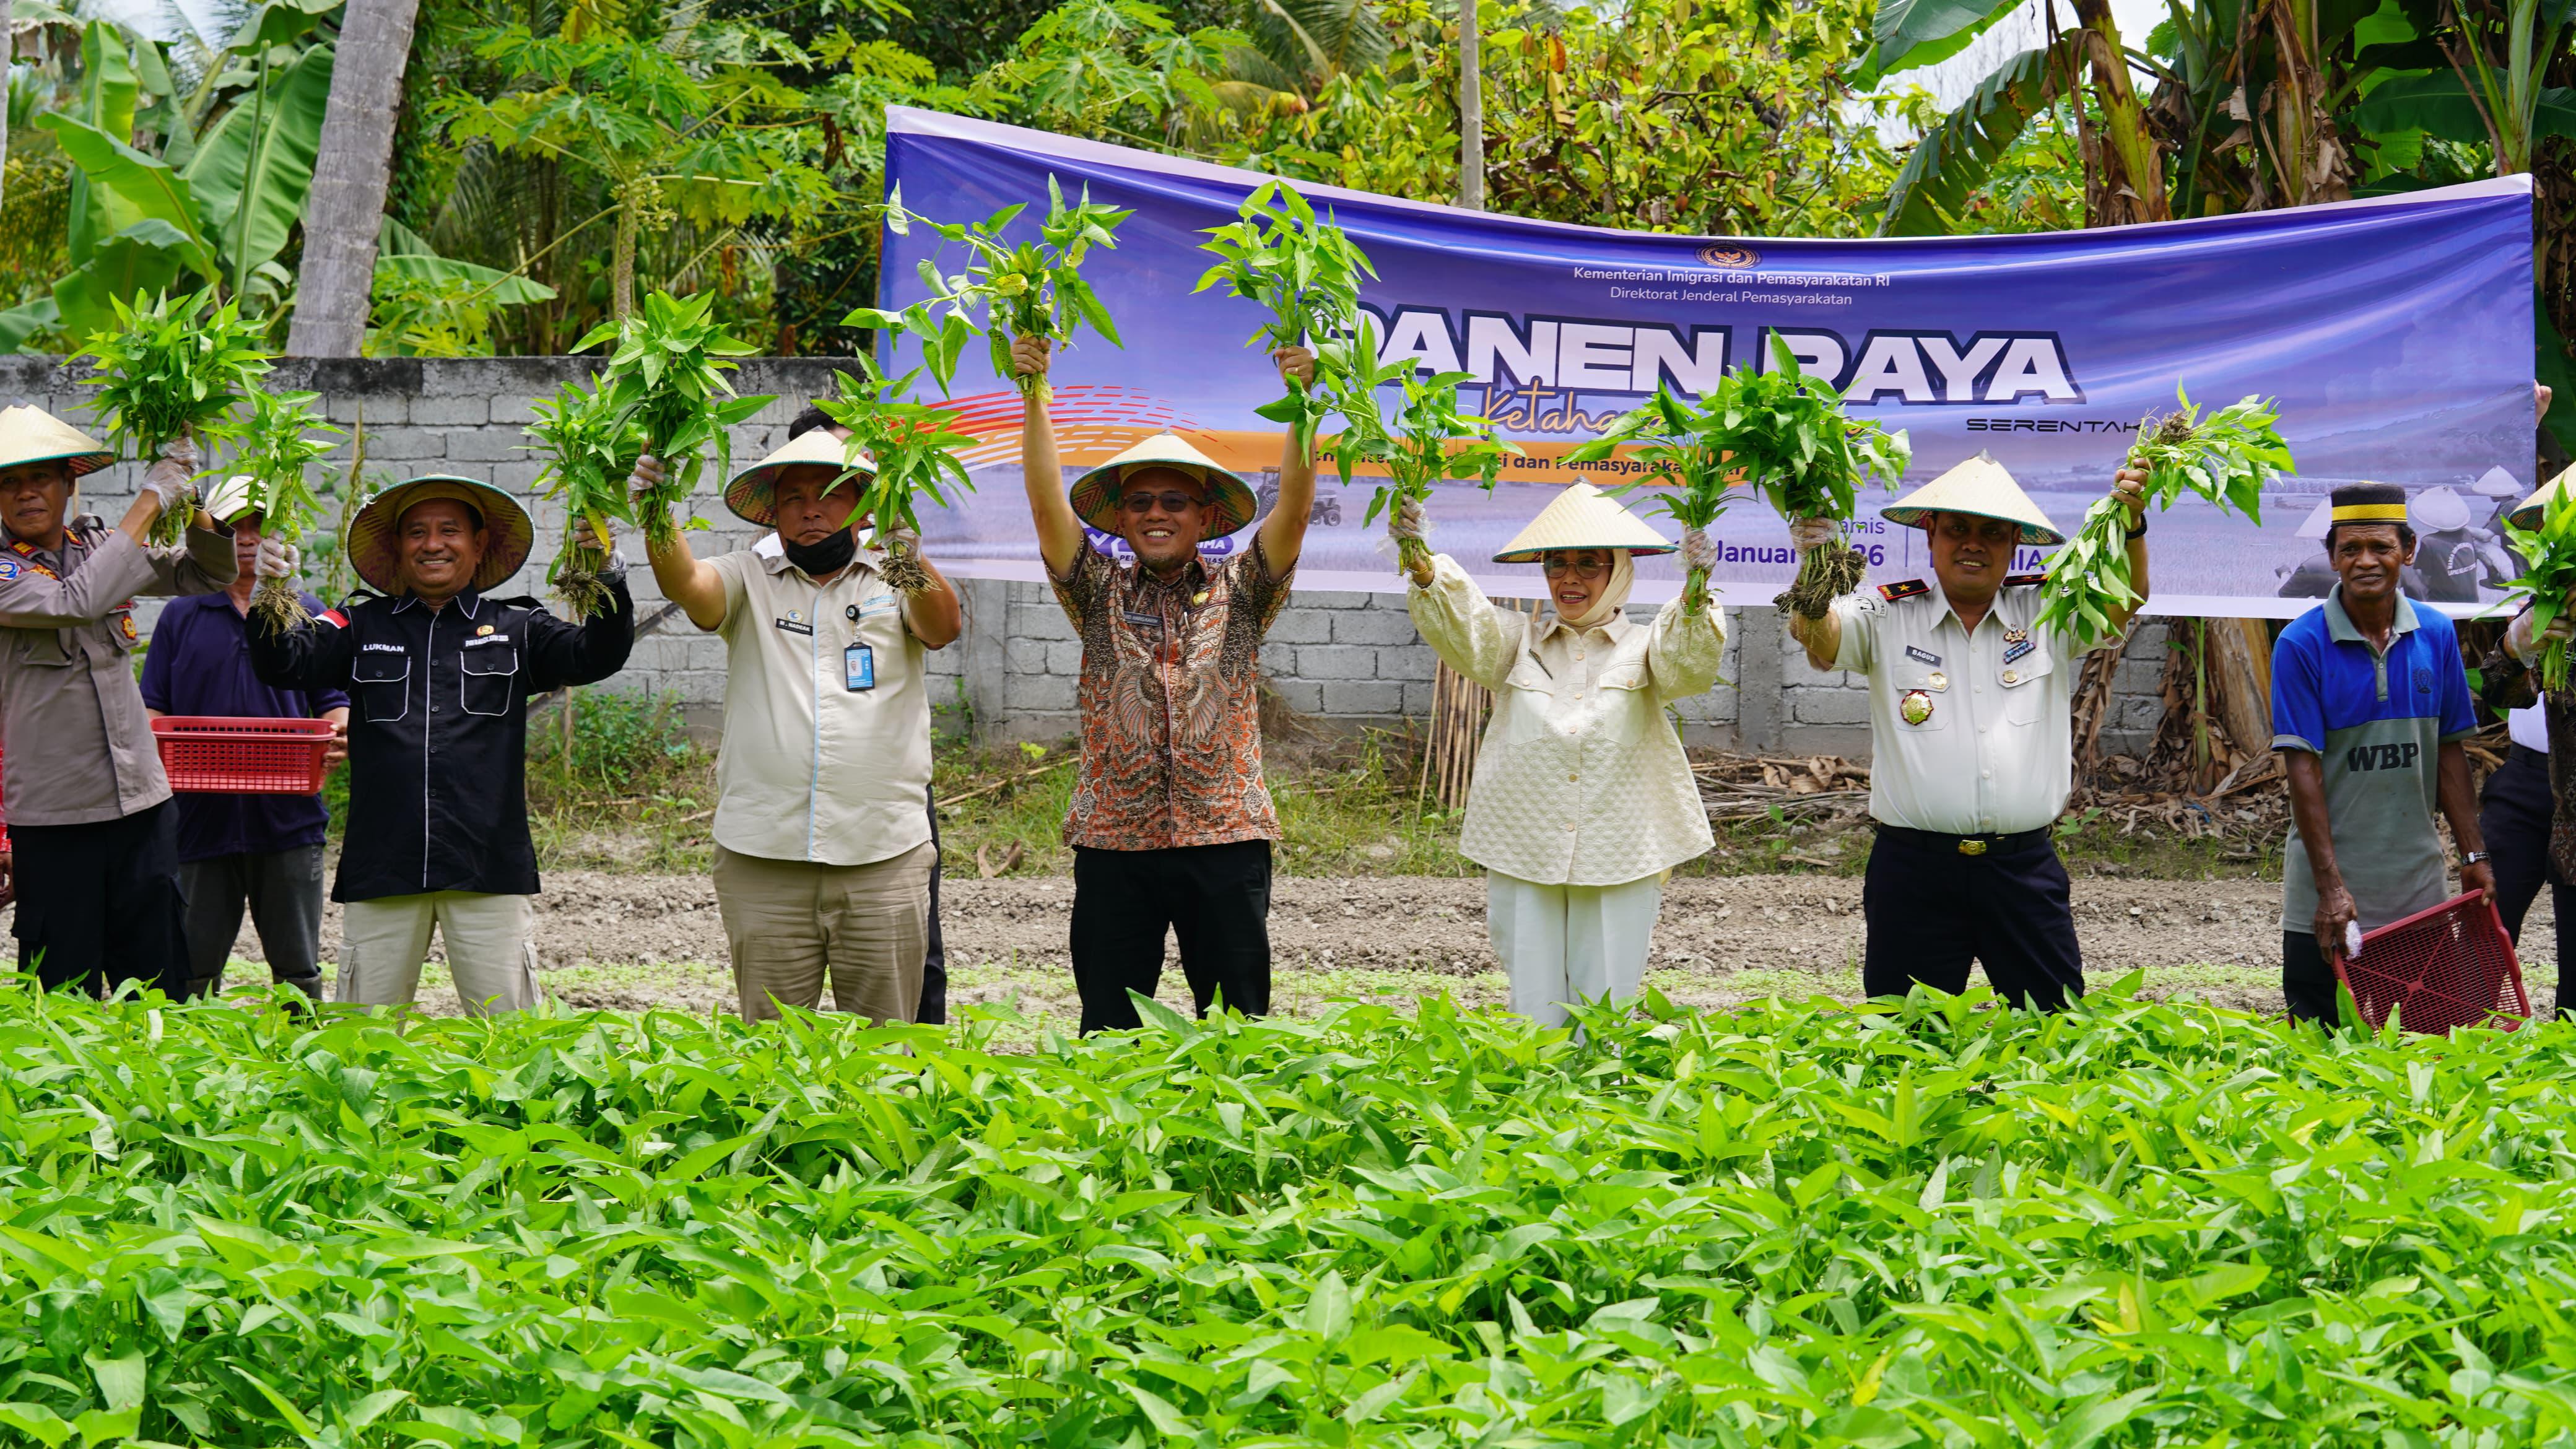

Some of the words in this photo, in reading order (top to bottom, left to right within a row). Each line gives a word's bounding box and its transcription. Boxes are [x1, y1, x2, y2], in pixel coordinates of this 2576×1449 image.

[1574, 266, 1663, 282] Kementerian
[1667, 270, 1723, 285] Imigrasi
[1726, 272, 1753, 284] dan
[1757, 273, 1872, 287] Pemasyarakatan
[1875, 274, 1890, 287] RI
[1610, 287, 1678, 301] Direktorat
[1681, 289, 1738, 302] Jenderal
[1741, 291, 1852, 306] Pemasyarakatan
[1966, 419, 2145, 433] SERENTAK
[1513, 455, 1550, 469] dan
[1837, 517, 1886, 534] amis
[1716, 539, 1797, 564] Januar
[363, 644, 404, 652] LUKMAN
[1912, 649, 1936, 662] BAGUS
[2348, 742, 2419, 772] WBP
